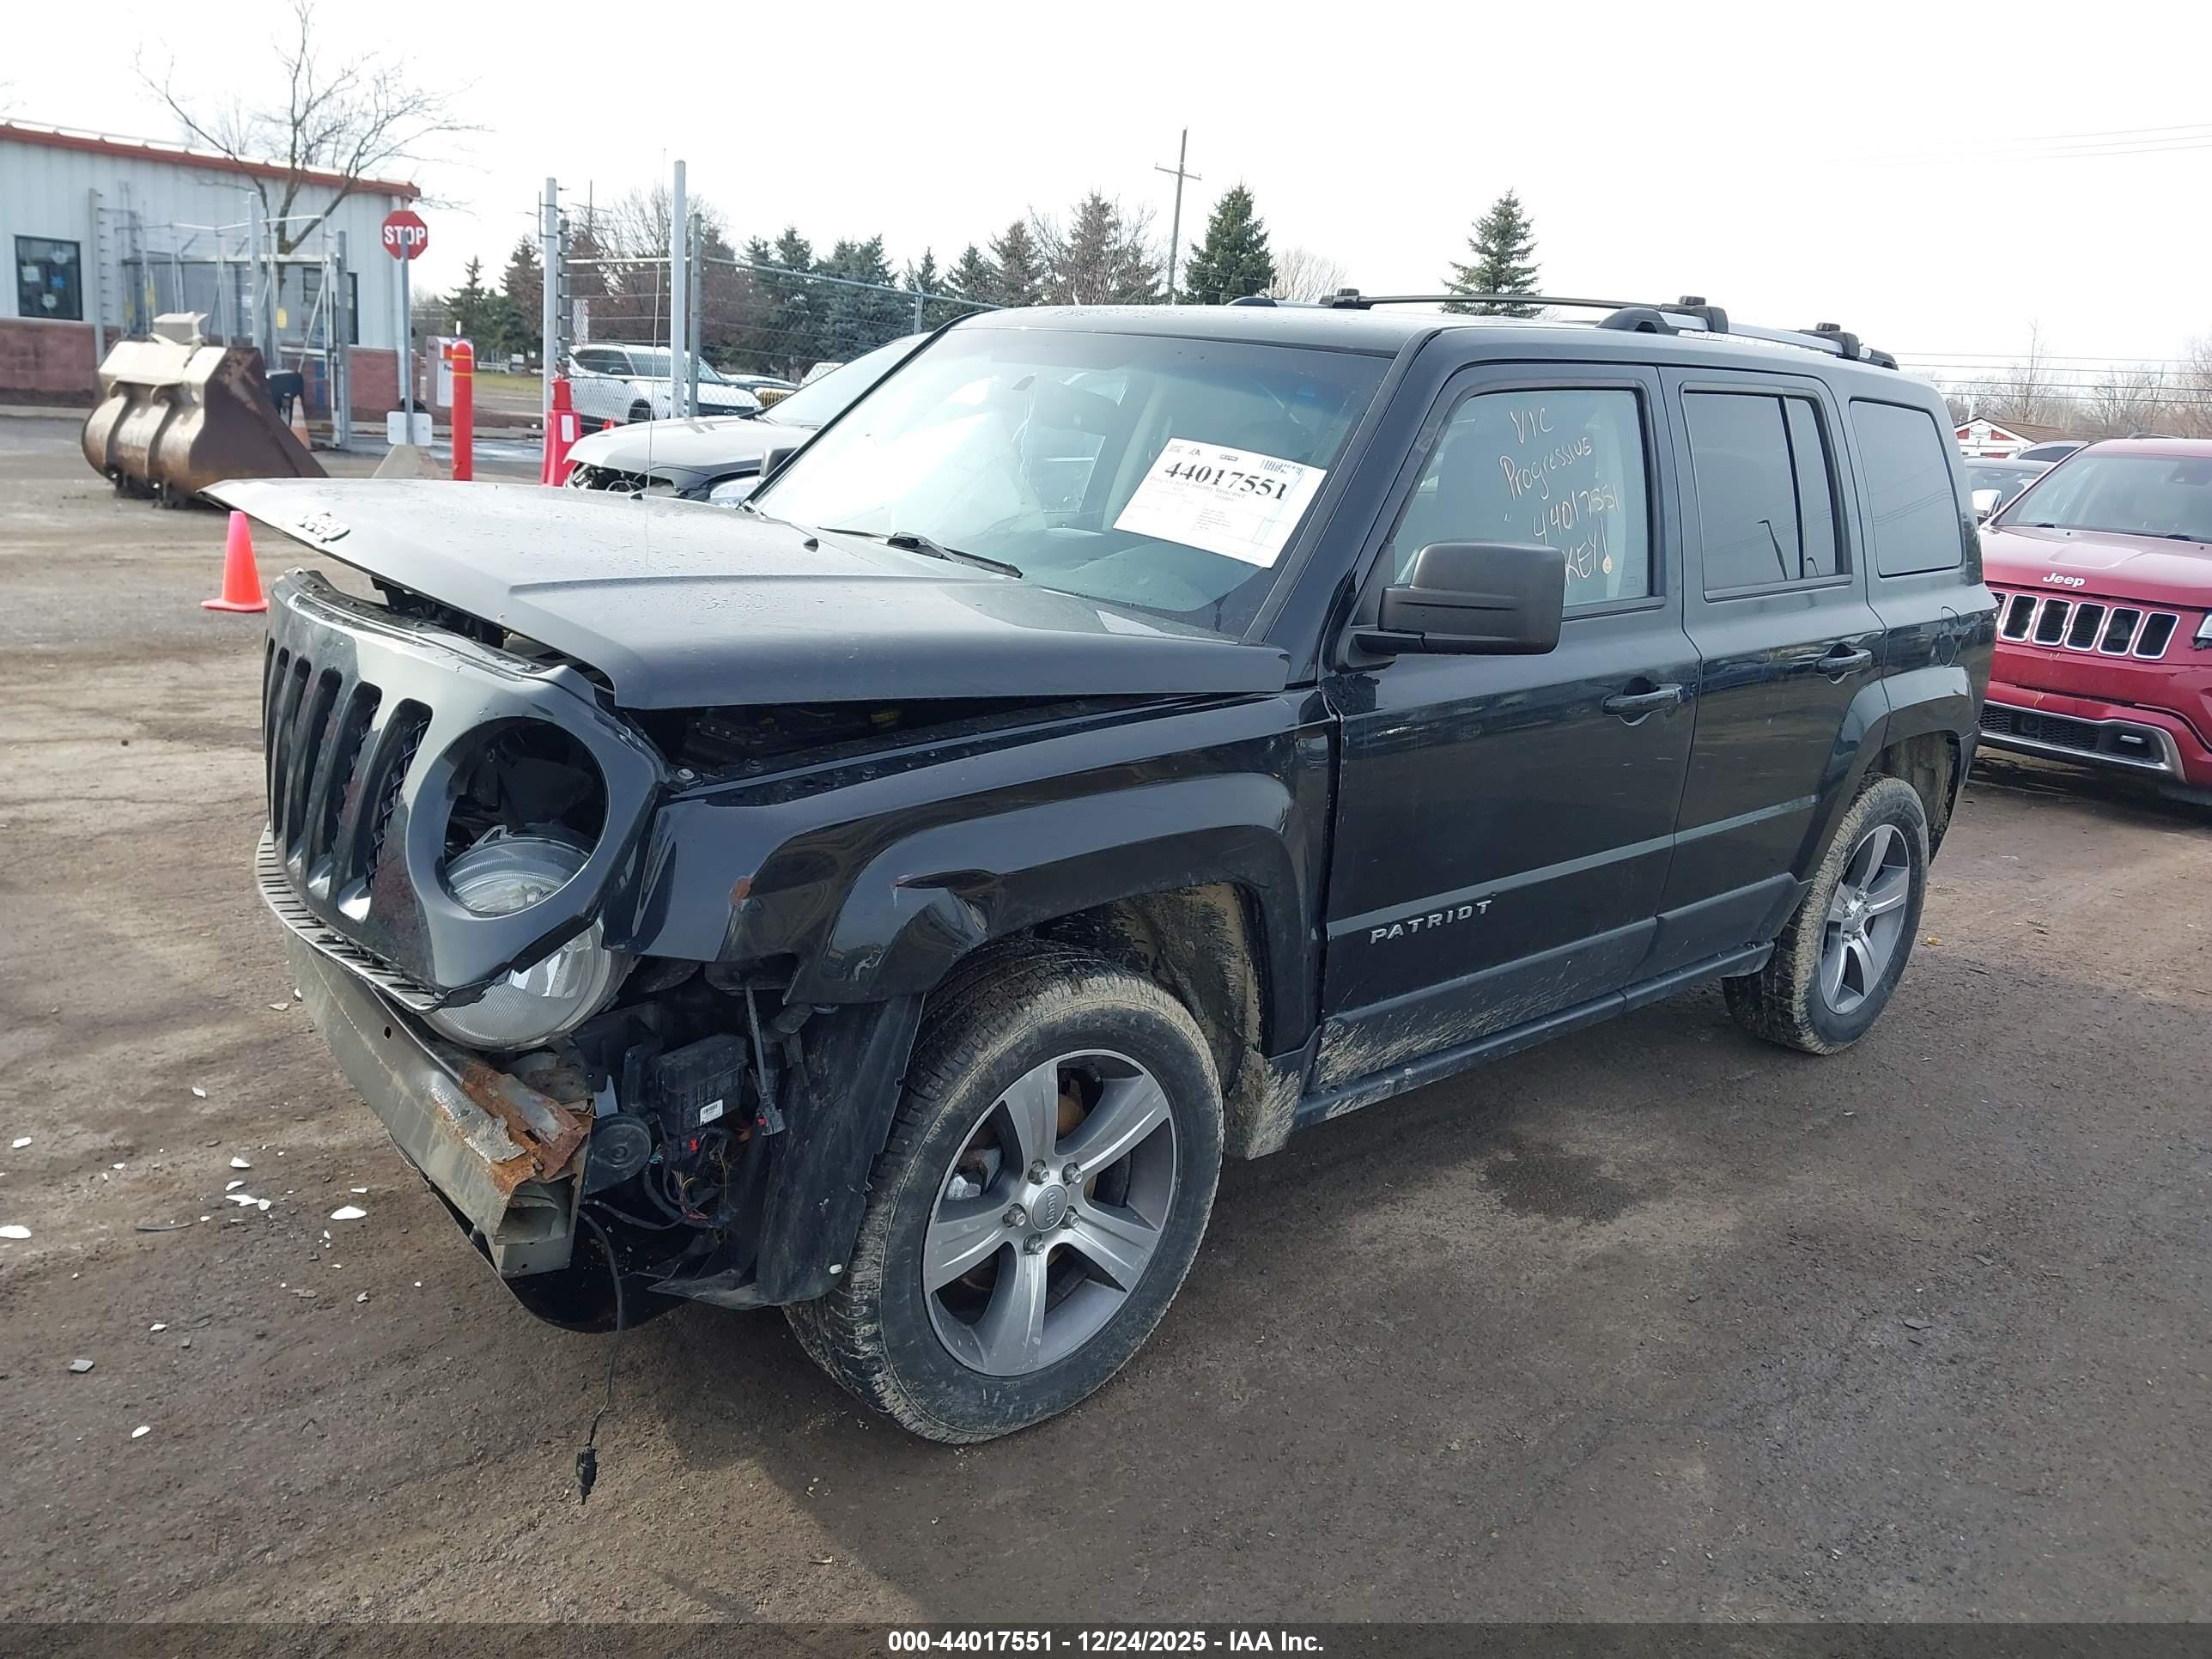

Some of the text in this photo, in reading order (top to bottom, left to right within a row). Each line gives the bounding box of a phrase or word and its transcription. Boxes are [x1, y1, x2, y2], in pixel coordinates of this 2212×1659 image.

[385, 225, 426, 246] STOP
[1509, 408, 1554, 444] VIC
[1164, 461, 1287, 501] 44017551
[1533, 481, 1620, 544] 44017551
[2042, 572, 2086, 588] Jeep
[1369, 899, 1492, 945] PATRIOT
